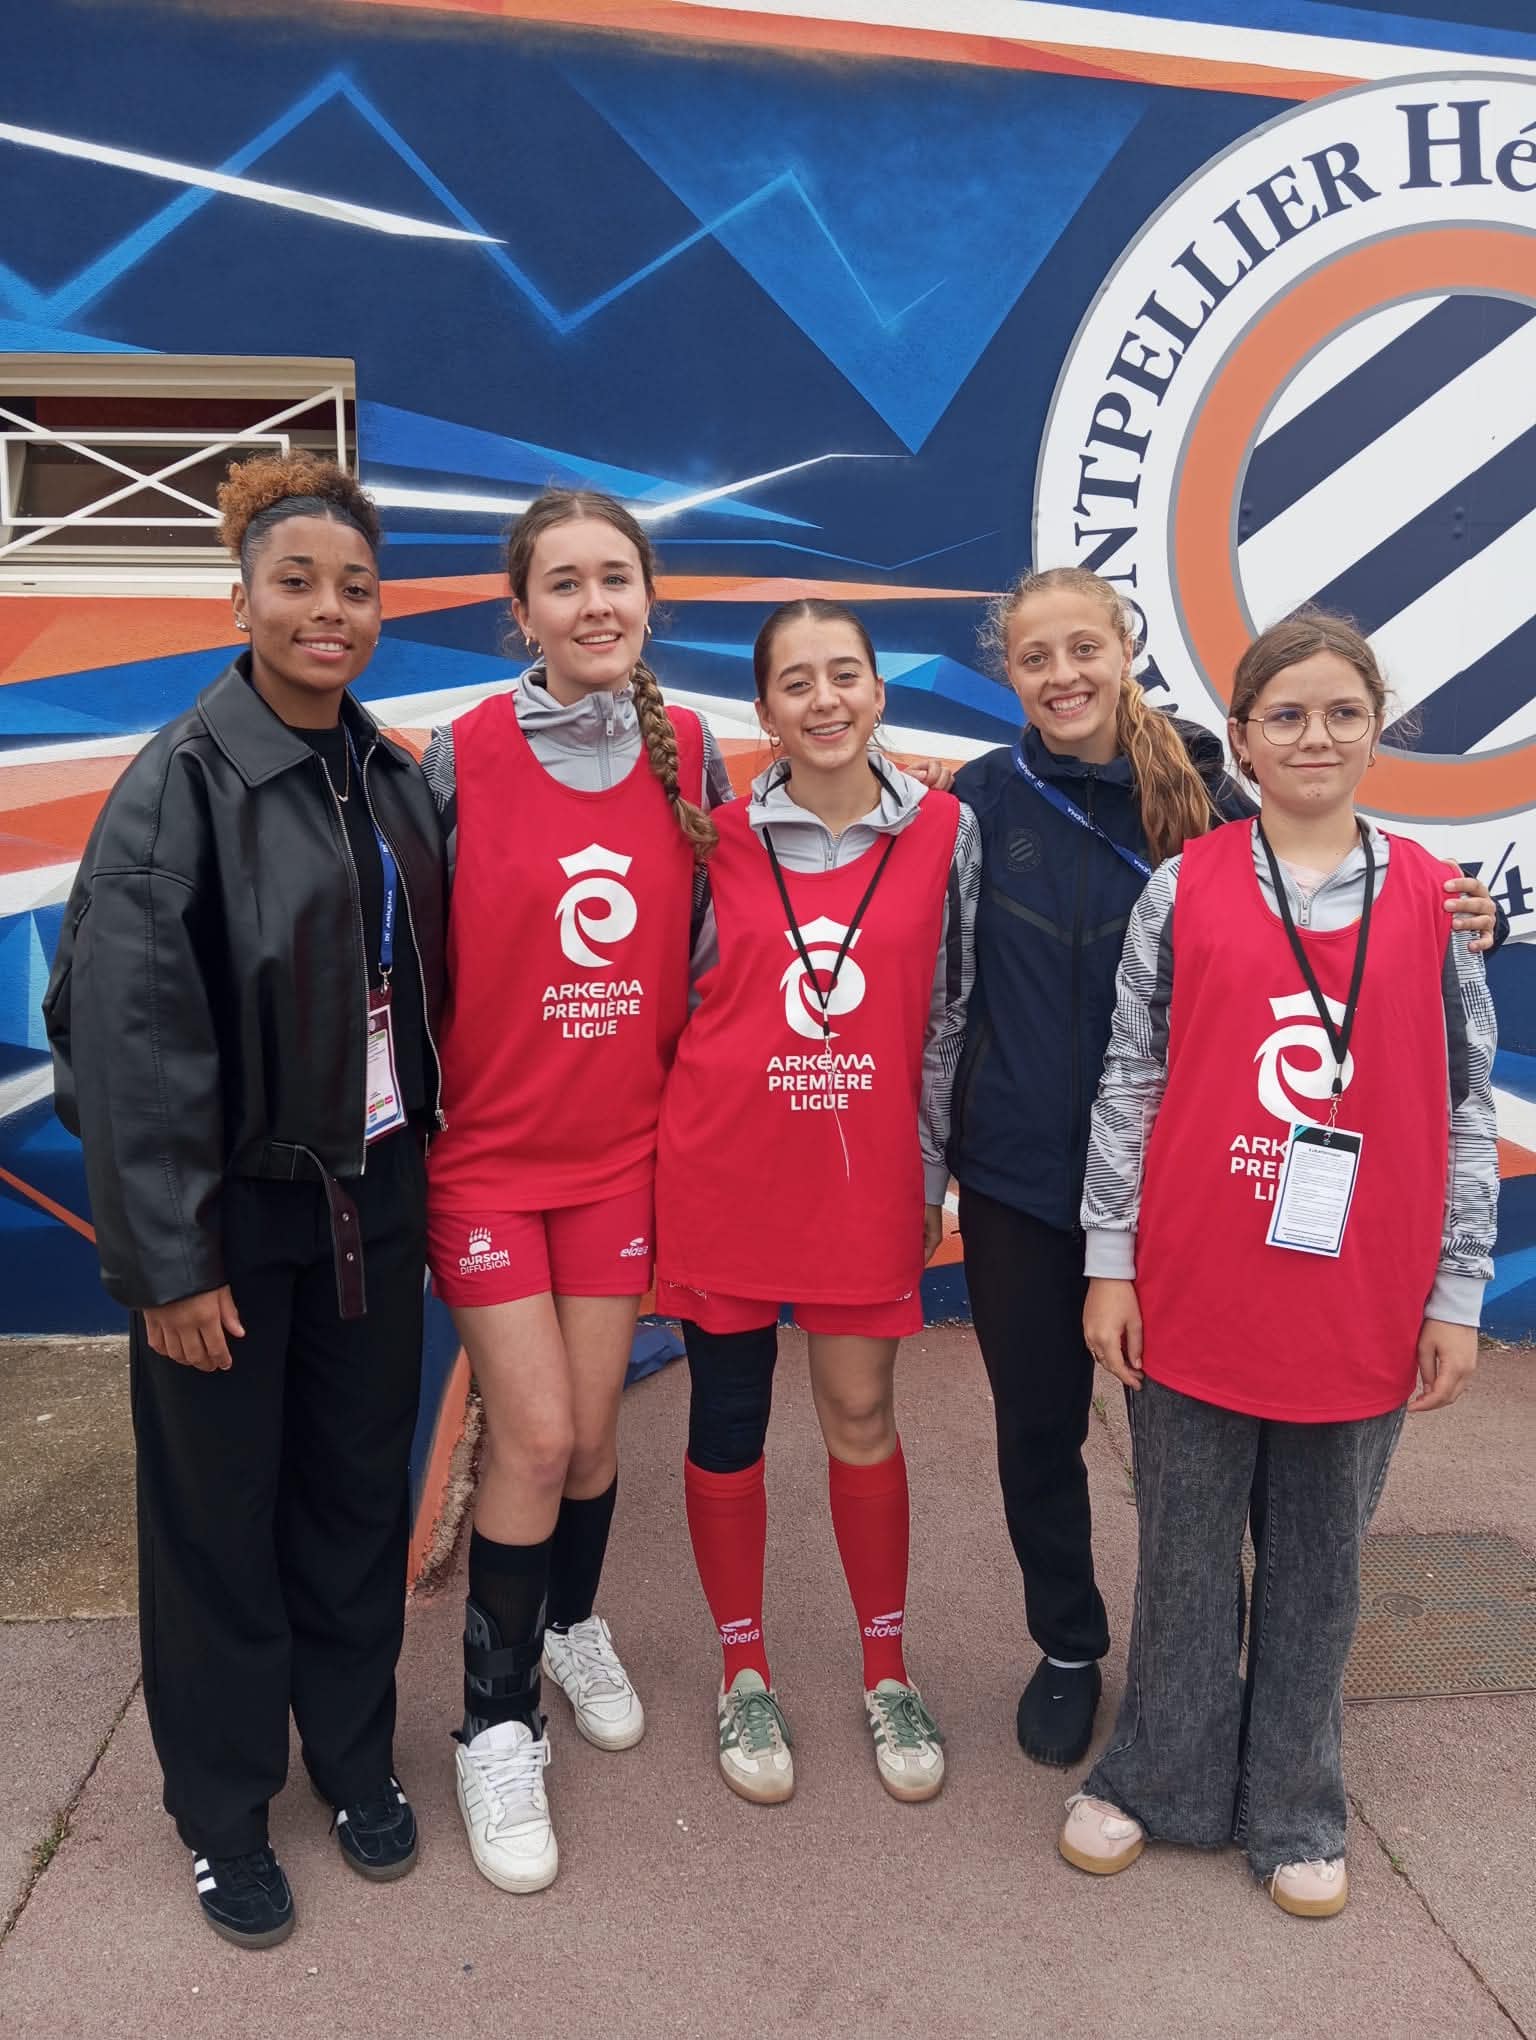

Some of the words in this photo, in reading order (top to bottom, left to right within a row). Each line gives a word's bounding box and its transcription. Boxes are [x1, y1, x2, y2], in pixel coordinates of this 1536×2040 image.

[1073, 141, 1382, 713] NTPELLIER
[541, 979, 644, 1003] ARKEMA
[543, 998, 641, 1021] PREMIÈRE
[562, 1019, 618, 1039] LIGUE
[766, 1053, 876, 1073] ARKEMA
[790, 1093, 849, 1111] LIGUE
[1229, 1133, 1289, 1157] ARK
[459, 1249, 510, 1267] OURSON
[460, 1259, 511, 1276] DIFFUSION
